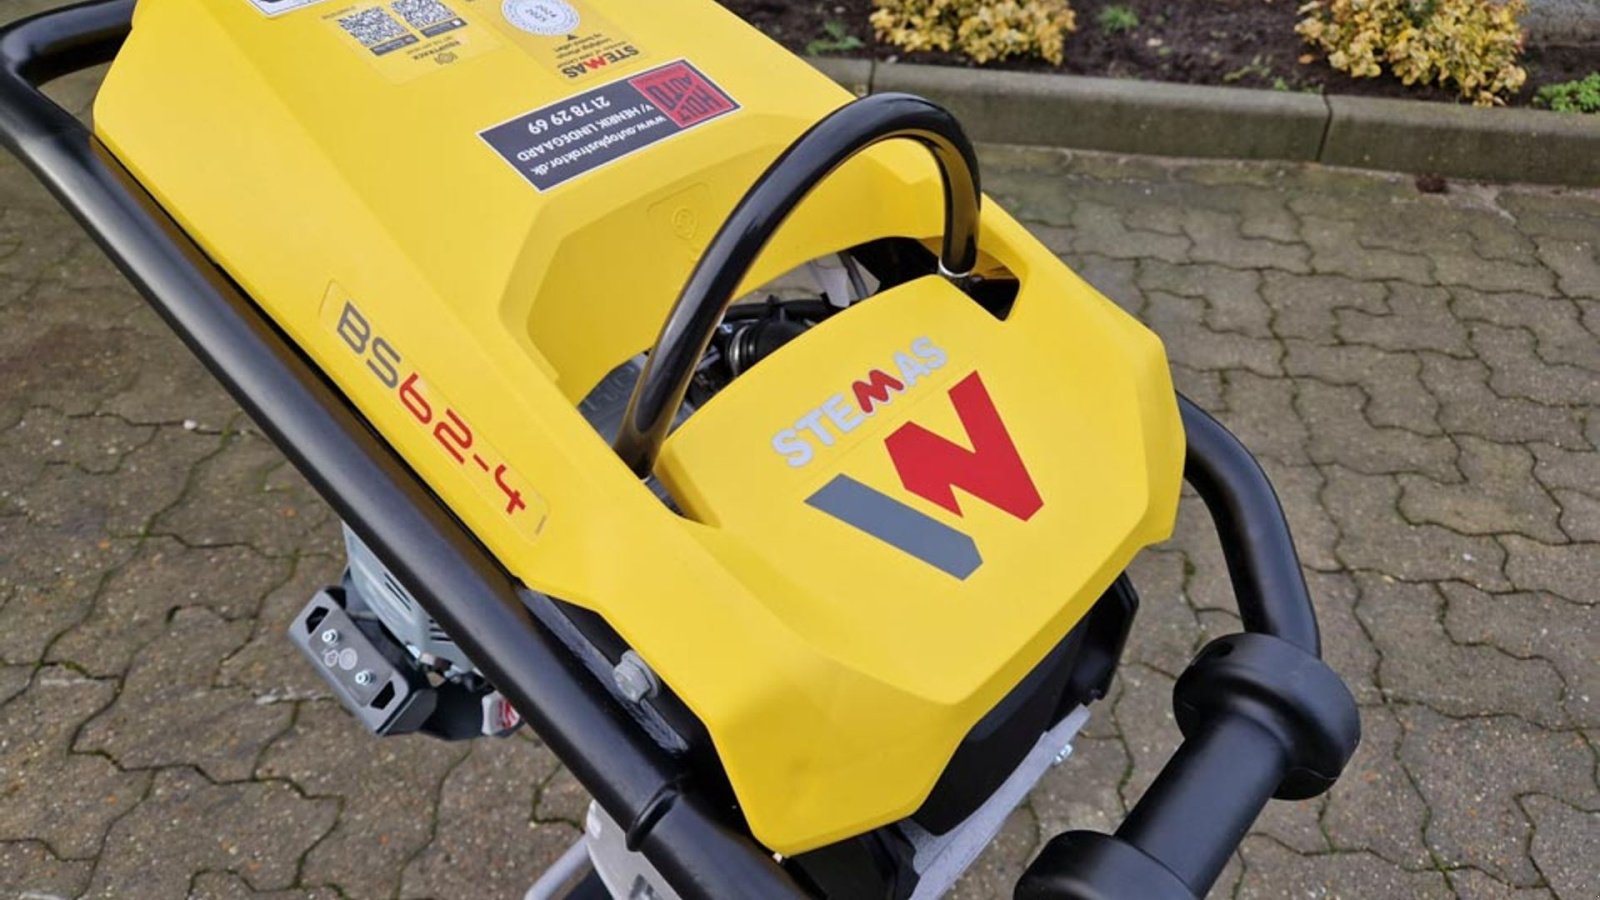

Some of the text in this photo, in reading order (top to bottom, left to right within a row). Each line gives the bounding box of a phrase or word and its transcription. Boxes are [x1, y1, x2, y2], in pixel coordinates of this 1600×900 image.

[561, 45, 639, 78] STEMAS
[648, 75, 693, 111] AUTO
[528, 96, 611, 135] 21 78 29 69
[600, 107, 641, 129] HENRIK
[517, 124, 599, 162] LINDEGAARD
[531, 115, 667, 176] www.autoplustraktor.dk
[336, 301, 526, 515] BS62-4
[771, 336, 948, 468] STEMAS
